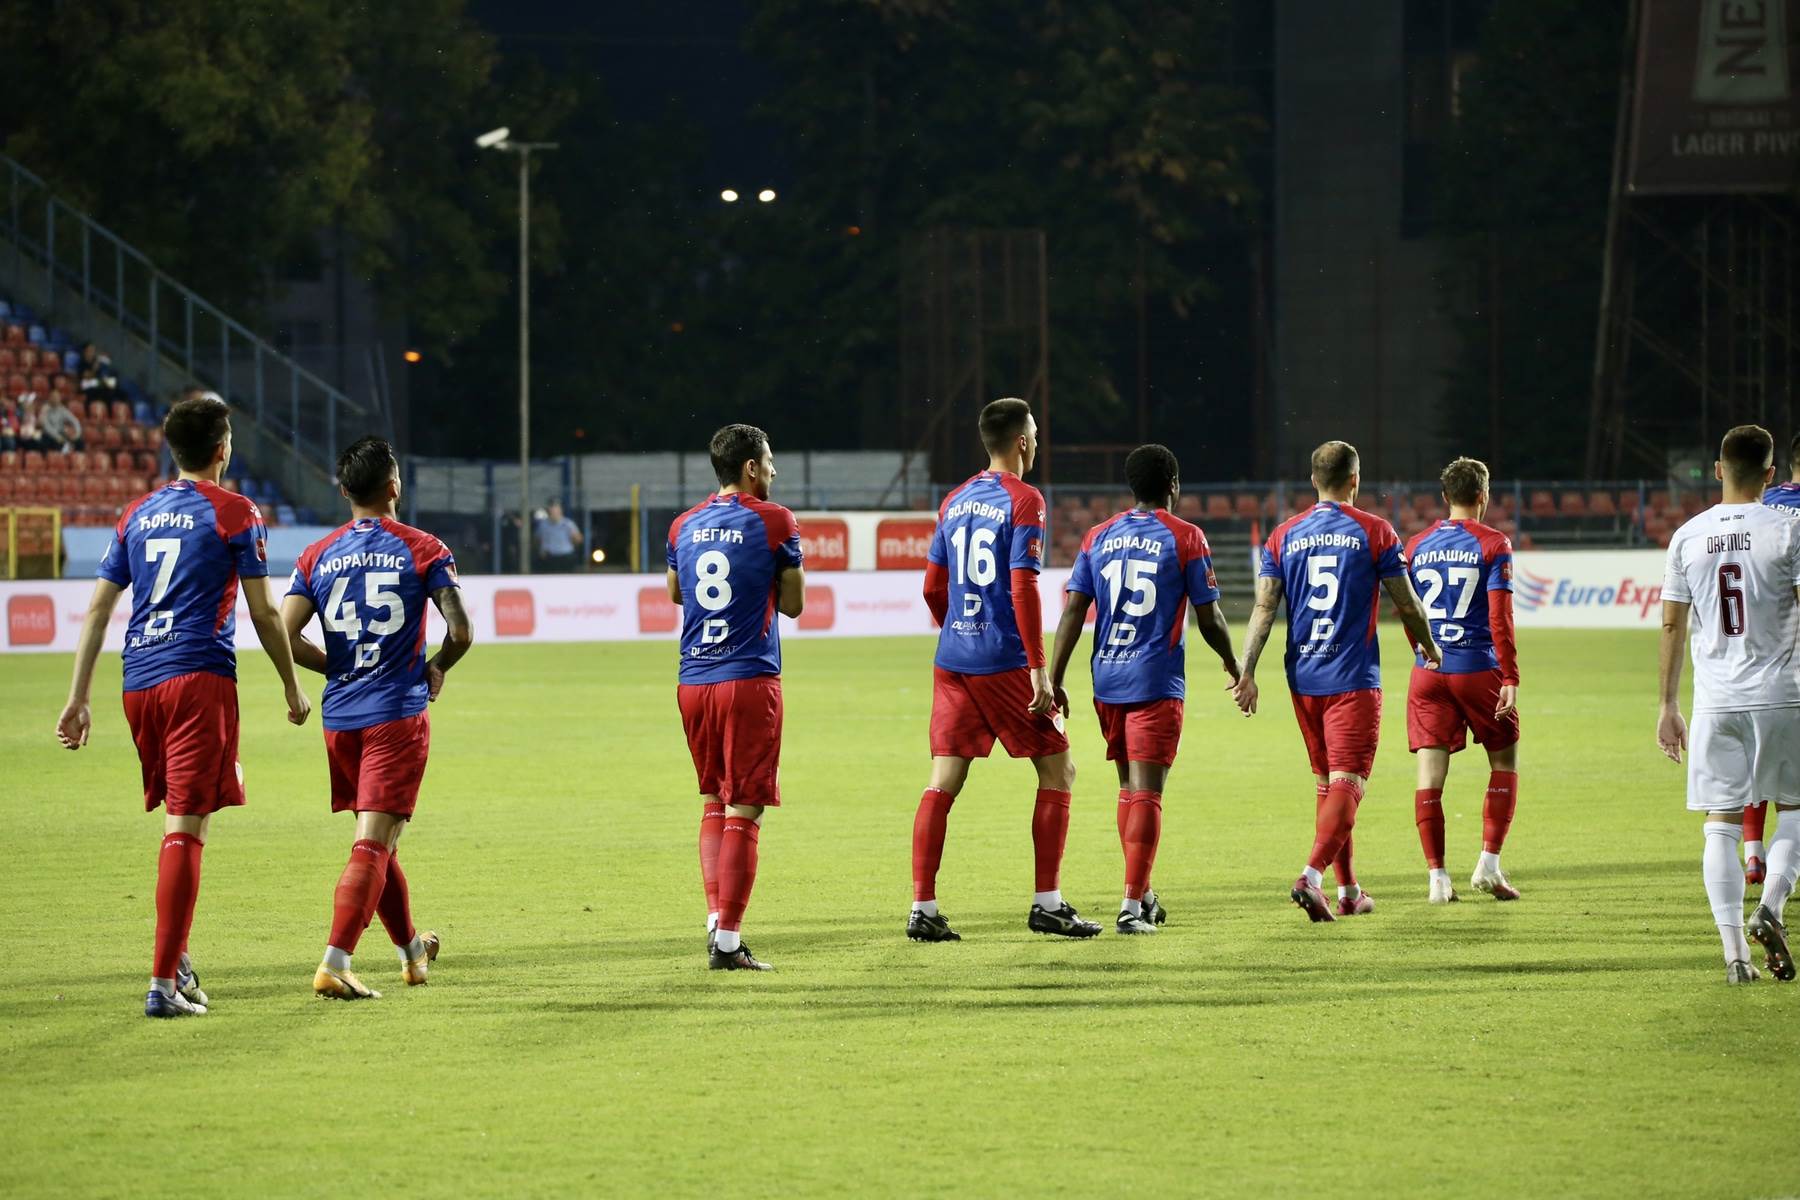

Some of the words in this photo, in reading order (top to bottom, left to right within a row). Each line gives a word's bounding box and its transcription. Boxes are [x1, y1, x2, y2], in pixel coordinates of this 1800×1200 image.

[1672, 132, 1744, 156] LAGER
[139, 512, 194, 531] ЋОРИЋ
[948, 500, 1006, 524] ВОЈНОВИЋ
[692, 528, 743, 544] БЕГИЋ
[1102, 536, 1161, 556] ДОНАЛД
[1286, 533, 1360, 556] ЈОВАНОВИЋ
[145, 538, 181, 604] 7
[319, 552, 405, 576] МОРАИТИС
[951, 526, 996, 587] 16
[1414, 549, 1479, 567] КУЛАШИН
[695, 550, 732, 611] 8
[1100, 559, 1157, 617] 15
[1307, 555, 1339, 611] 5
[1416, 567, 1480, 619] 27
[324, 571, 405, 640] 45
[1719, 563, 1745, 637] 6
